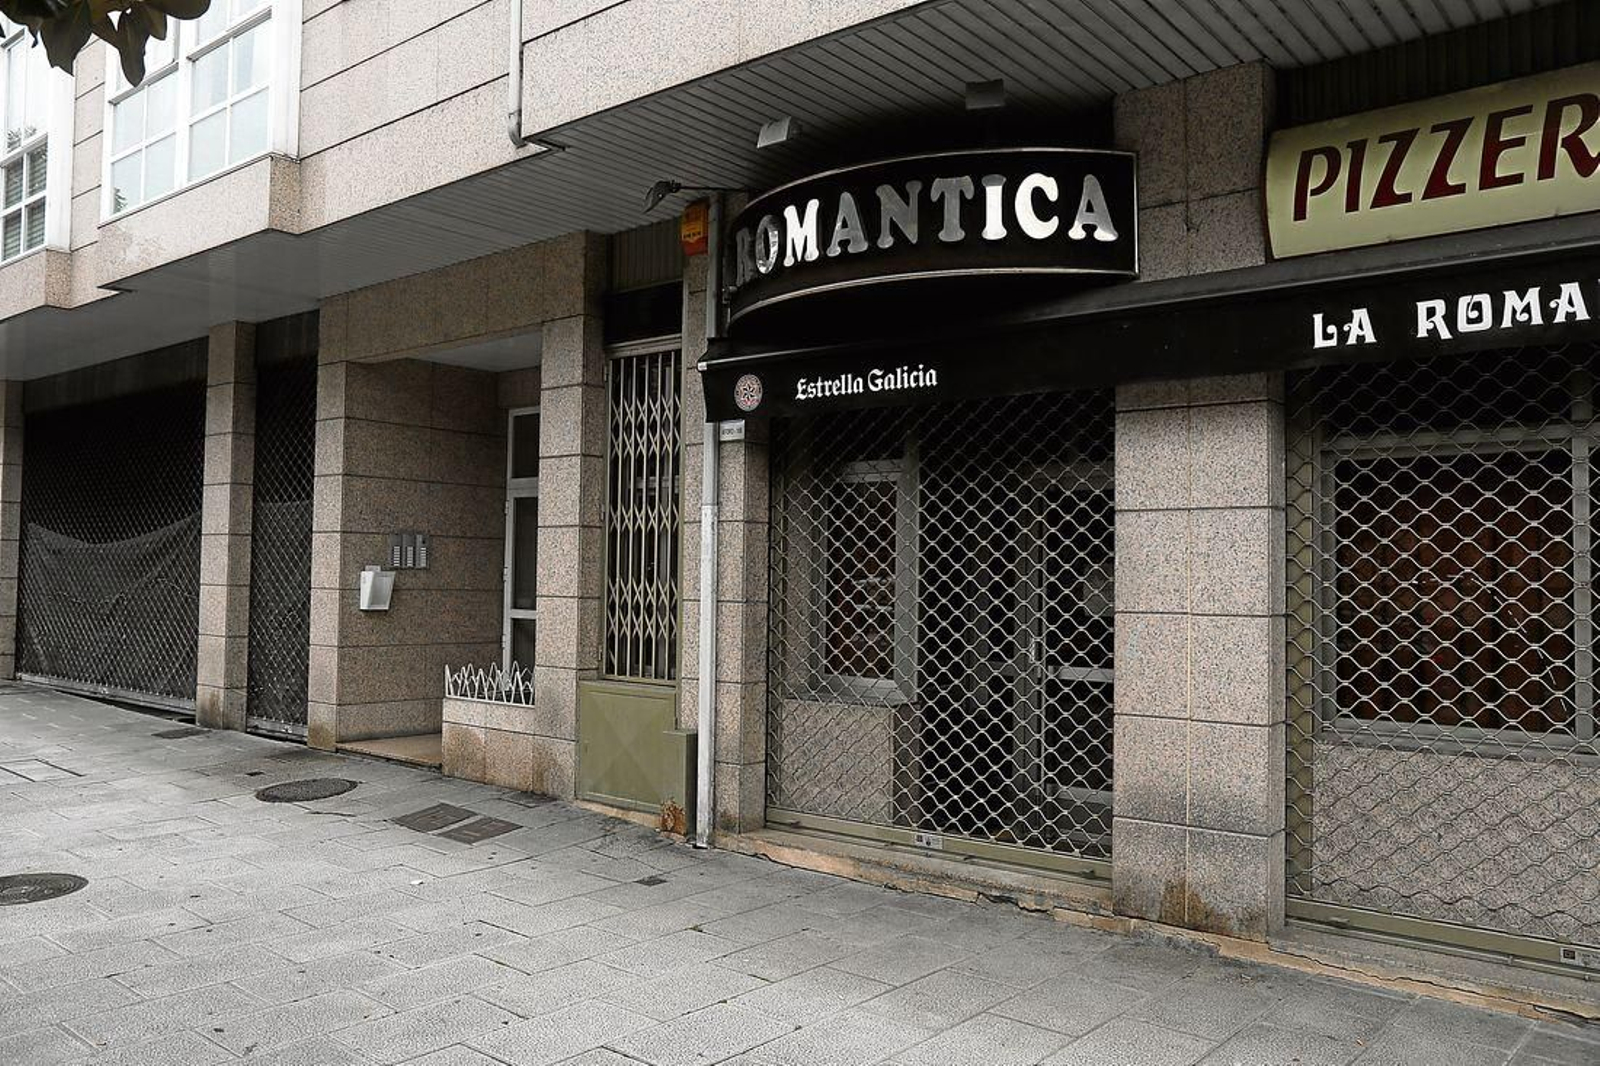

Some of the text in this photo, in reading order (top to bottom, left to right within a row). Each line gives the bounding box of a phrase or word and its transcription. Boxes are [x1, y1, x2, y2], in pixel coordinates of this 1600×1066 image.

[1293, 93, 1600, 221] PIZZER
[736, 172, 1118, 287] ROMANTICA
[1312, 280, 1600, 349] LA ROMA
[795, 373, 864, 400] Estrella
[867, 364, 938, 392] Galicia
